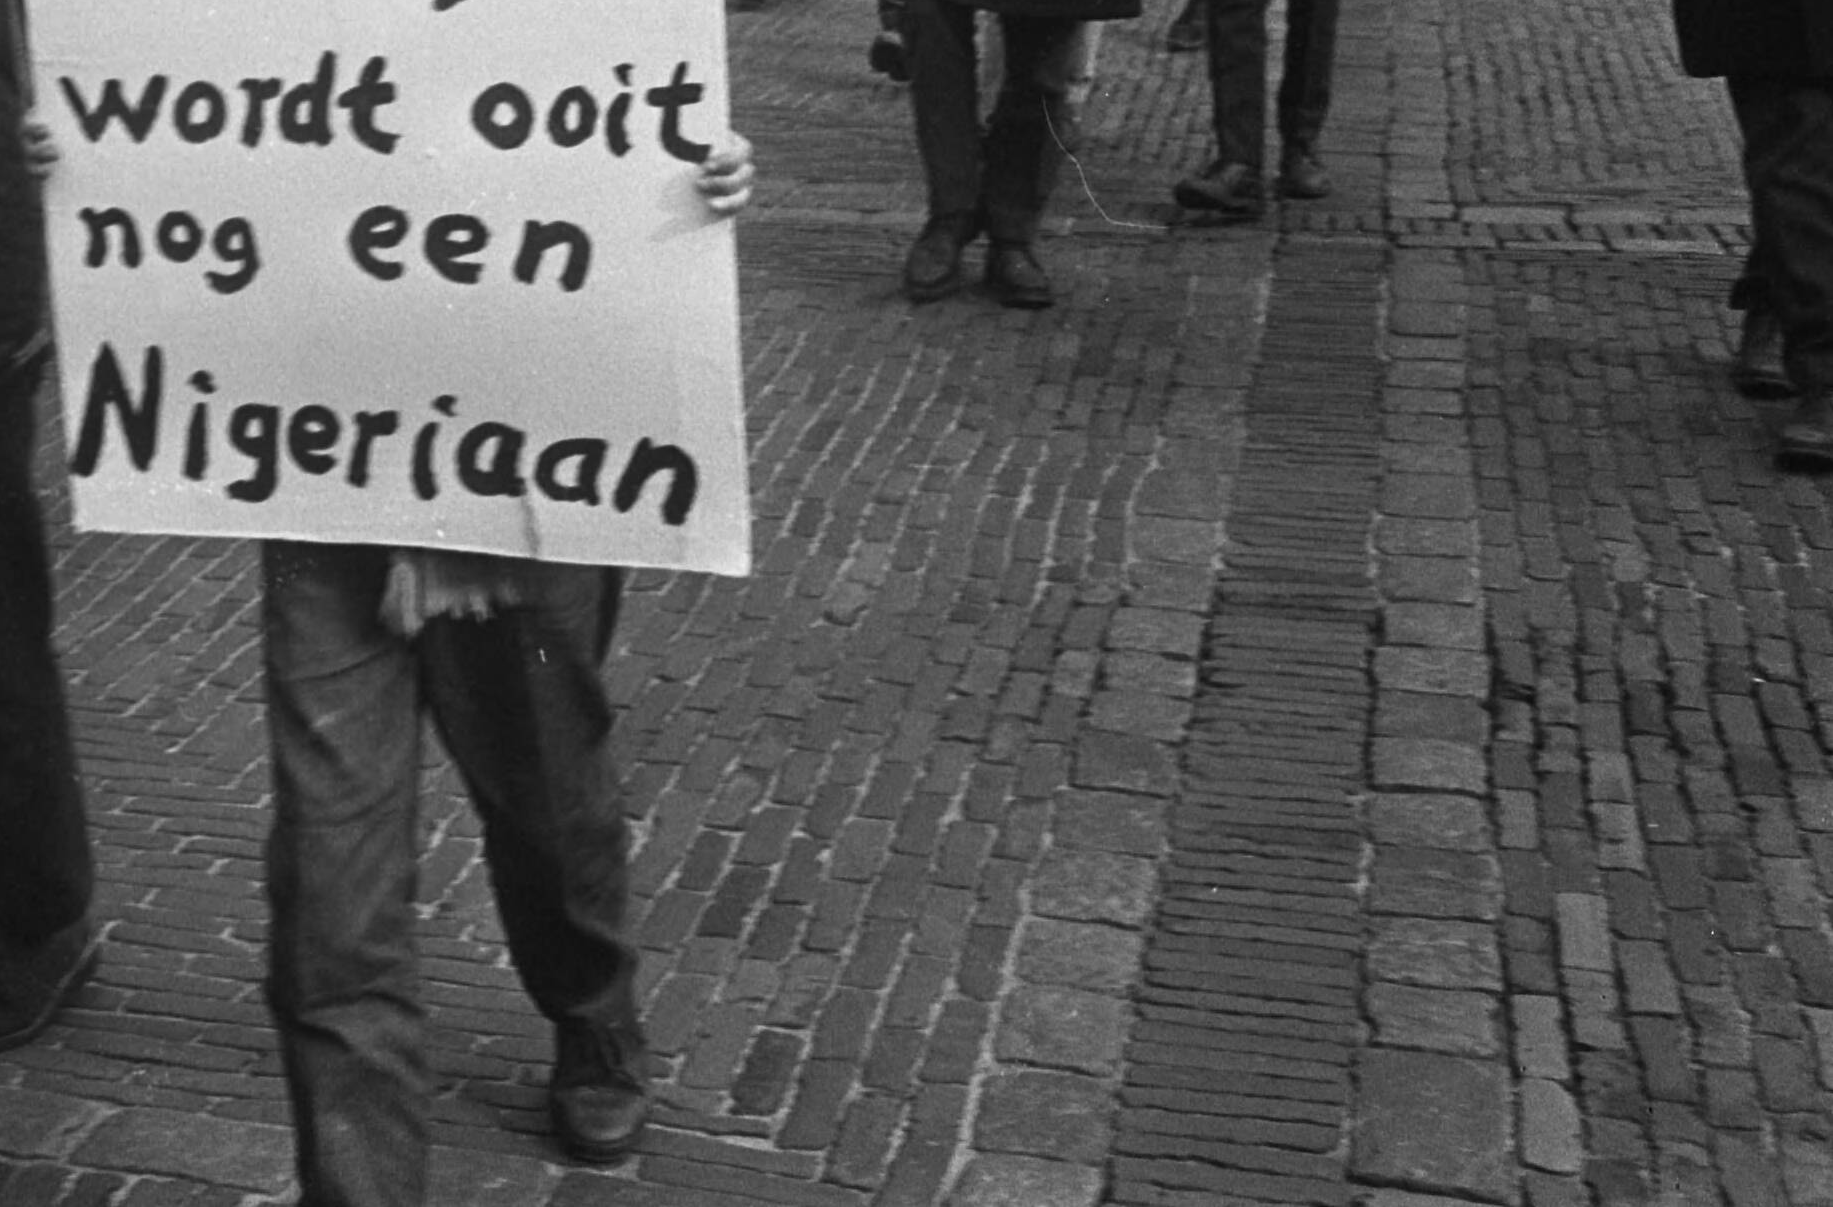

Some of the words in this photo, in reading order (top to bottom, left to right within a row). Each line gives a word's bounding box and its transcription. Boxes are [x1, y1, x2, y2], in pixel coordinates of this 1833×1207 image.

[59, 50, 402, 155] wordt
[471, 60, 714, 163] ooit
[79, 206, 260, 295] nog
[348, 204, 593, 293] een
[71, 342, 699, 527] Nigeriaan
